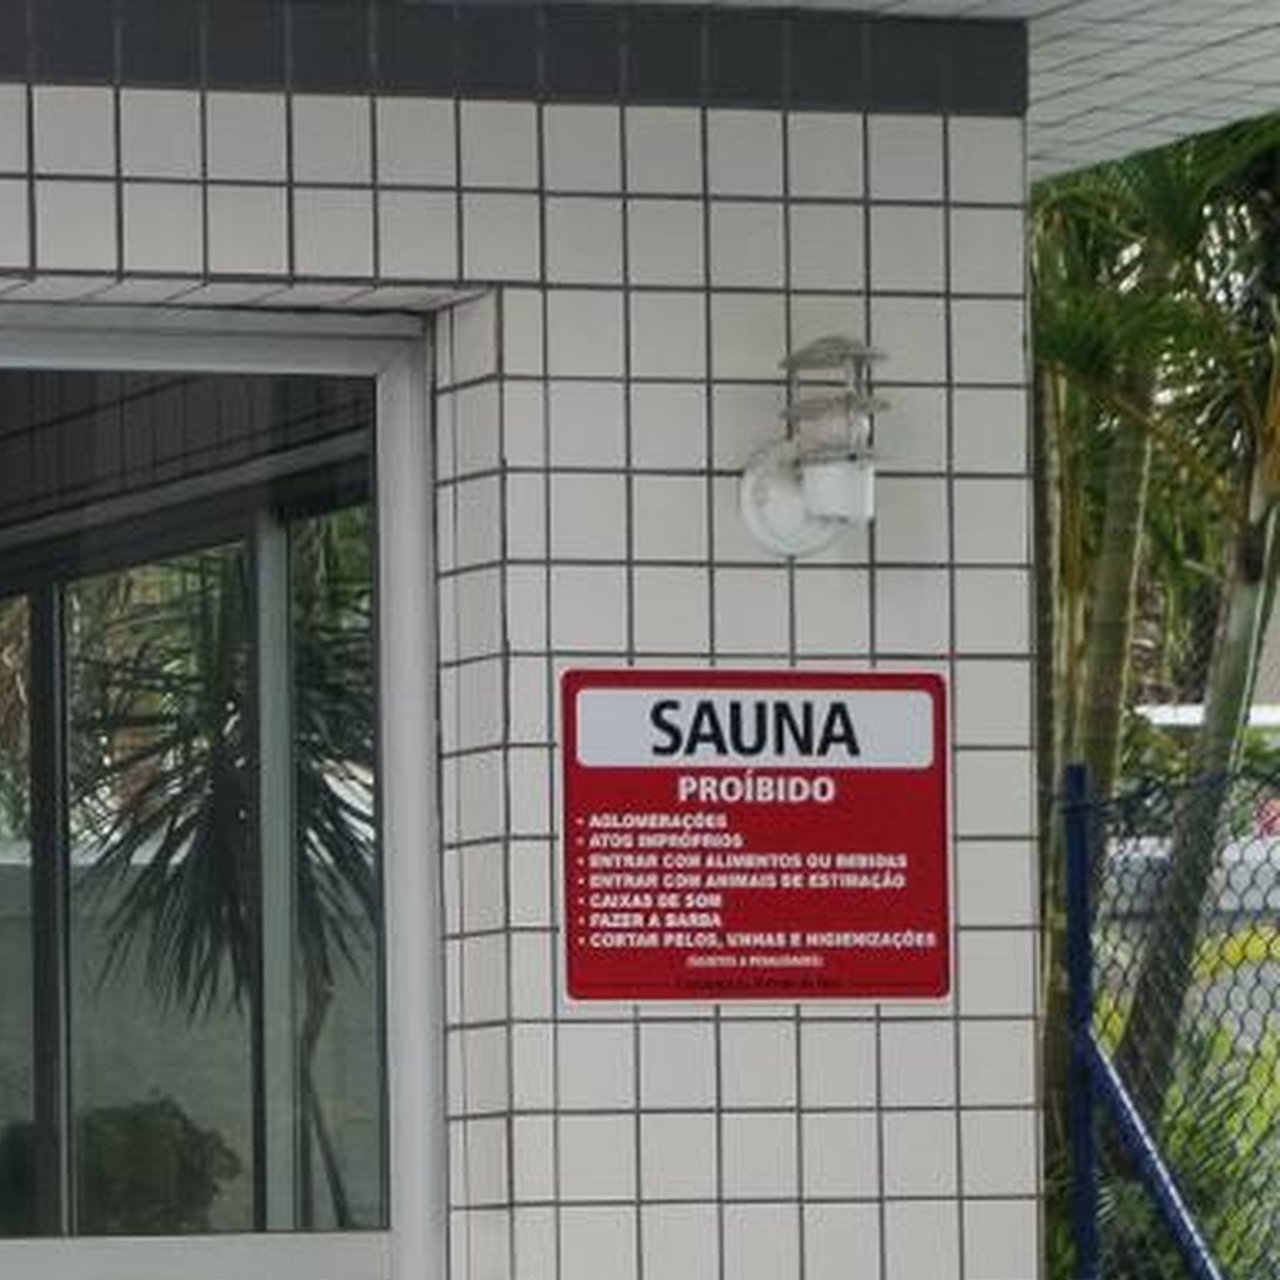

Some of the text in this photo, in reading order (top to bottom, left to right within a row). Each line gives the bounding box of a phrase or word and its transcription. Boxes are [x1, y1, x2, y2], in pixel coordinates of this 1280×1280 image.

[649, 699, 861, 756] SAUNA
[589, 853, 658, 869] ENTRAR
[662, 853, 701, 869] COM
[806, 853, 833, 868] OU
[589, 873, 658, 889] ENTRAR
[662, 873, 701, 888] COM
